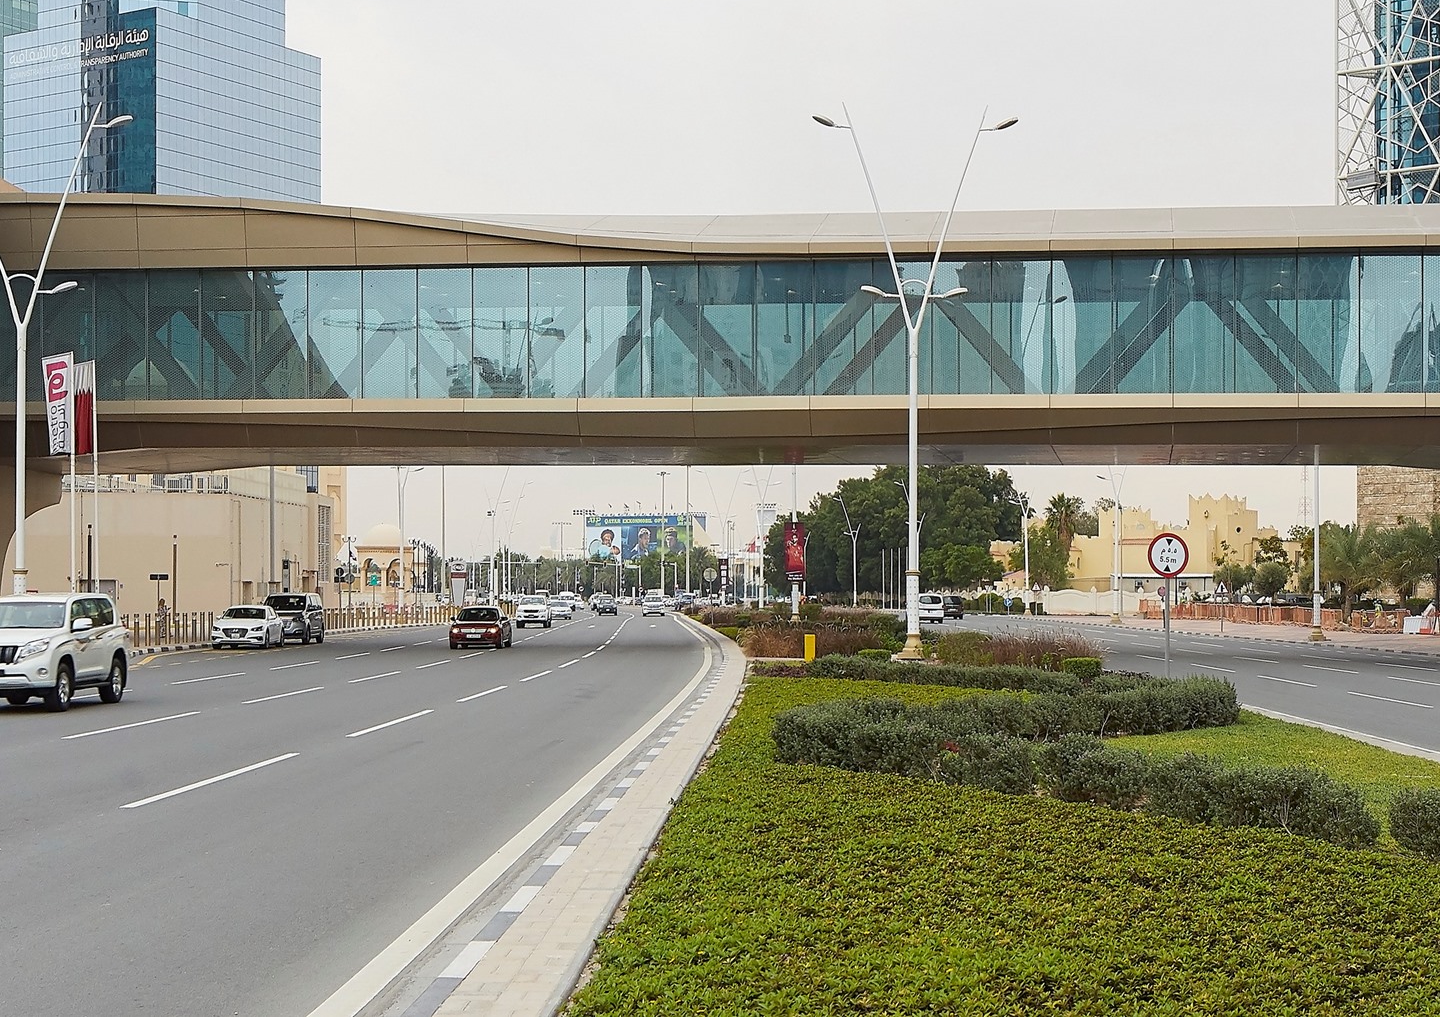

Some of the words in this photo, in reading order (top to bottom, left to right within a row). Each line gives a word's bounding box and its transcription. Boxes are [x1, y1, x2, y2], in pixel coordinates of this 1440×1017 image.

[95, 30, 124, 51] الرقابة
[125, 28, 149, 45] هيئة
[80, 53, 120, 68] RANSPARENCY
[119, 48, 149, 61] AUTHORITY
